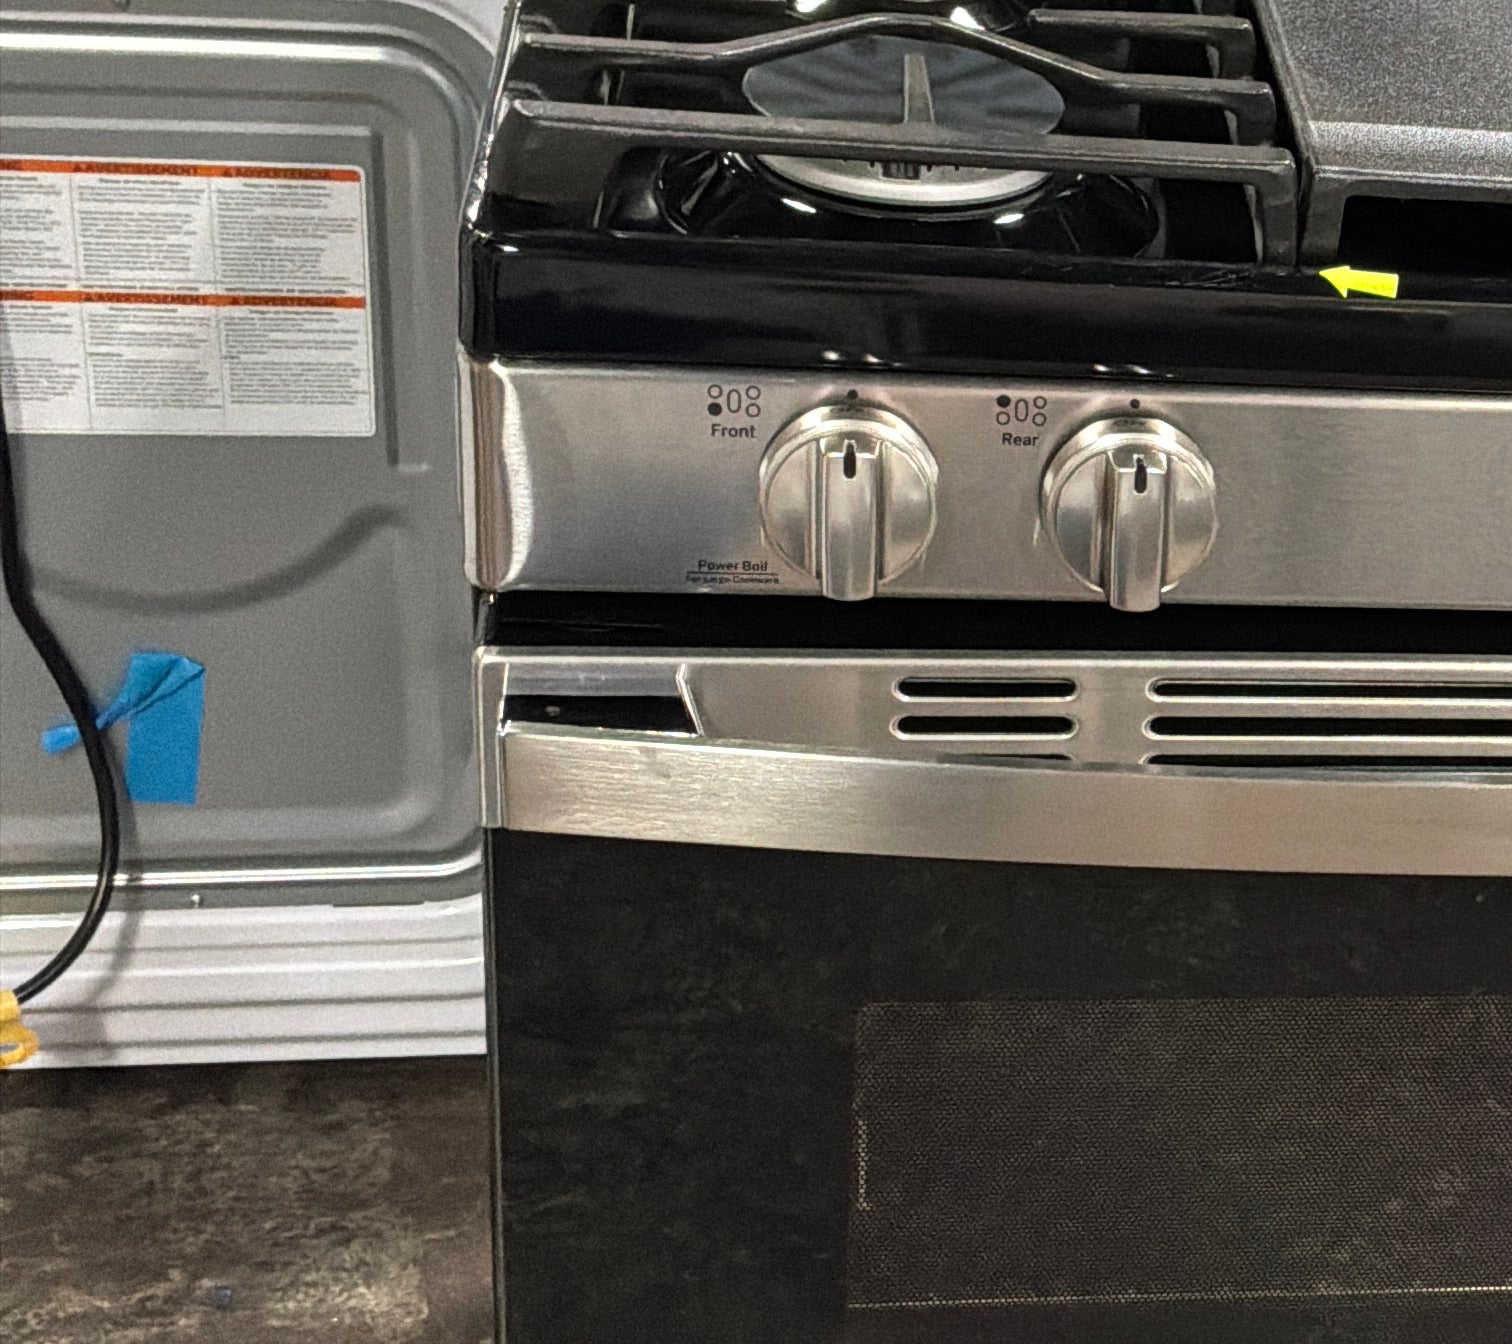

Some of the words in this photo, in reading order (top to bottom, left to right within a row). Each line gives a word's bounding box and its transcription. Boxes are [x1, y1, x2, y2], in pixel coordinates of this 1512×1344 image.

[711, 423, 756, 438] Front
[1002, 432, 1040, 446] Rear
[698, 559, 740, 571] Power
[742, 560, 768, 572] Boil
